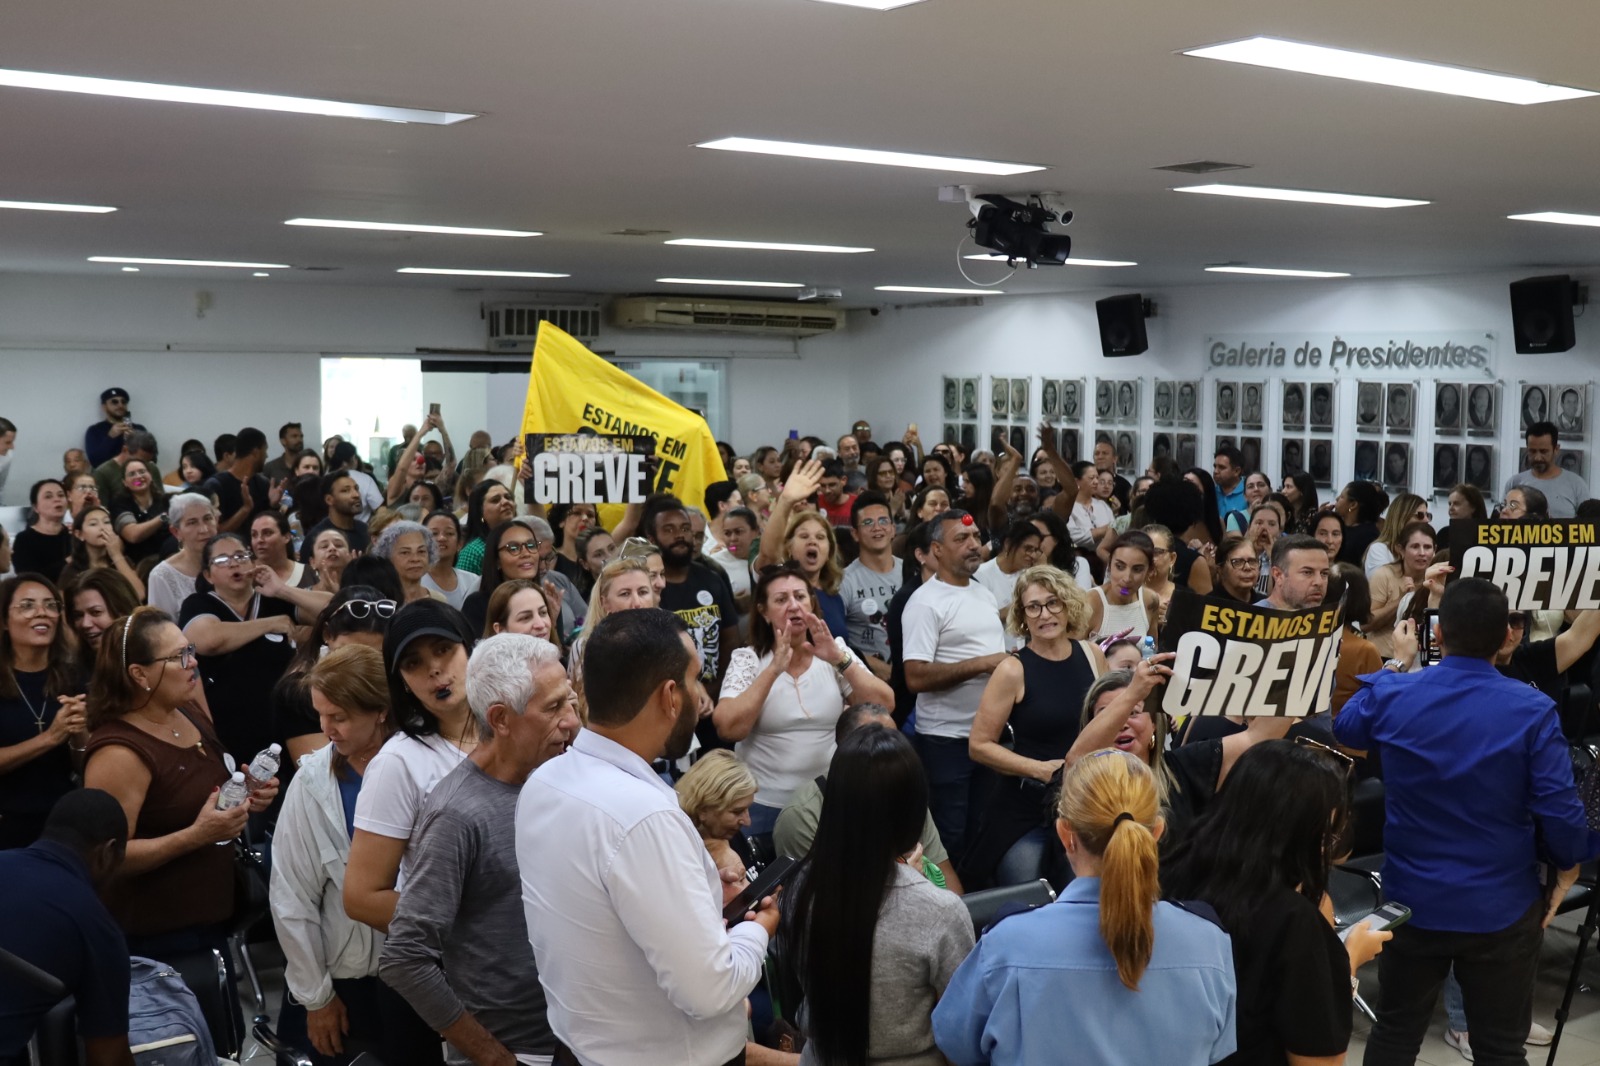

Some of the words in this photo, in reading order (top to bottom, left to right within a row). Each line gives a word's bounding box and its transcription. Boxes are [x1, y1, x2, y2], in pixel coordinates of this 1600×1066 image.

[1209, 341, 1286, 367] Galeria
[1294, 341, 1322, 367] de
[1329, 340, 1487, 368] Presidentes
[544, 437, 608, 453] ESTAMOS
[613, 438, 634, 453] EM
[661, 436, 687, 460] EM
[533, 452, 647, 504] GREVE
[1478, 524, 1563, 545] ESTAMOS
[1568, 524, 1596, 544] EM
[1201, 603, 1315, 640] ESTAMOS
